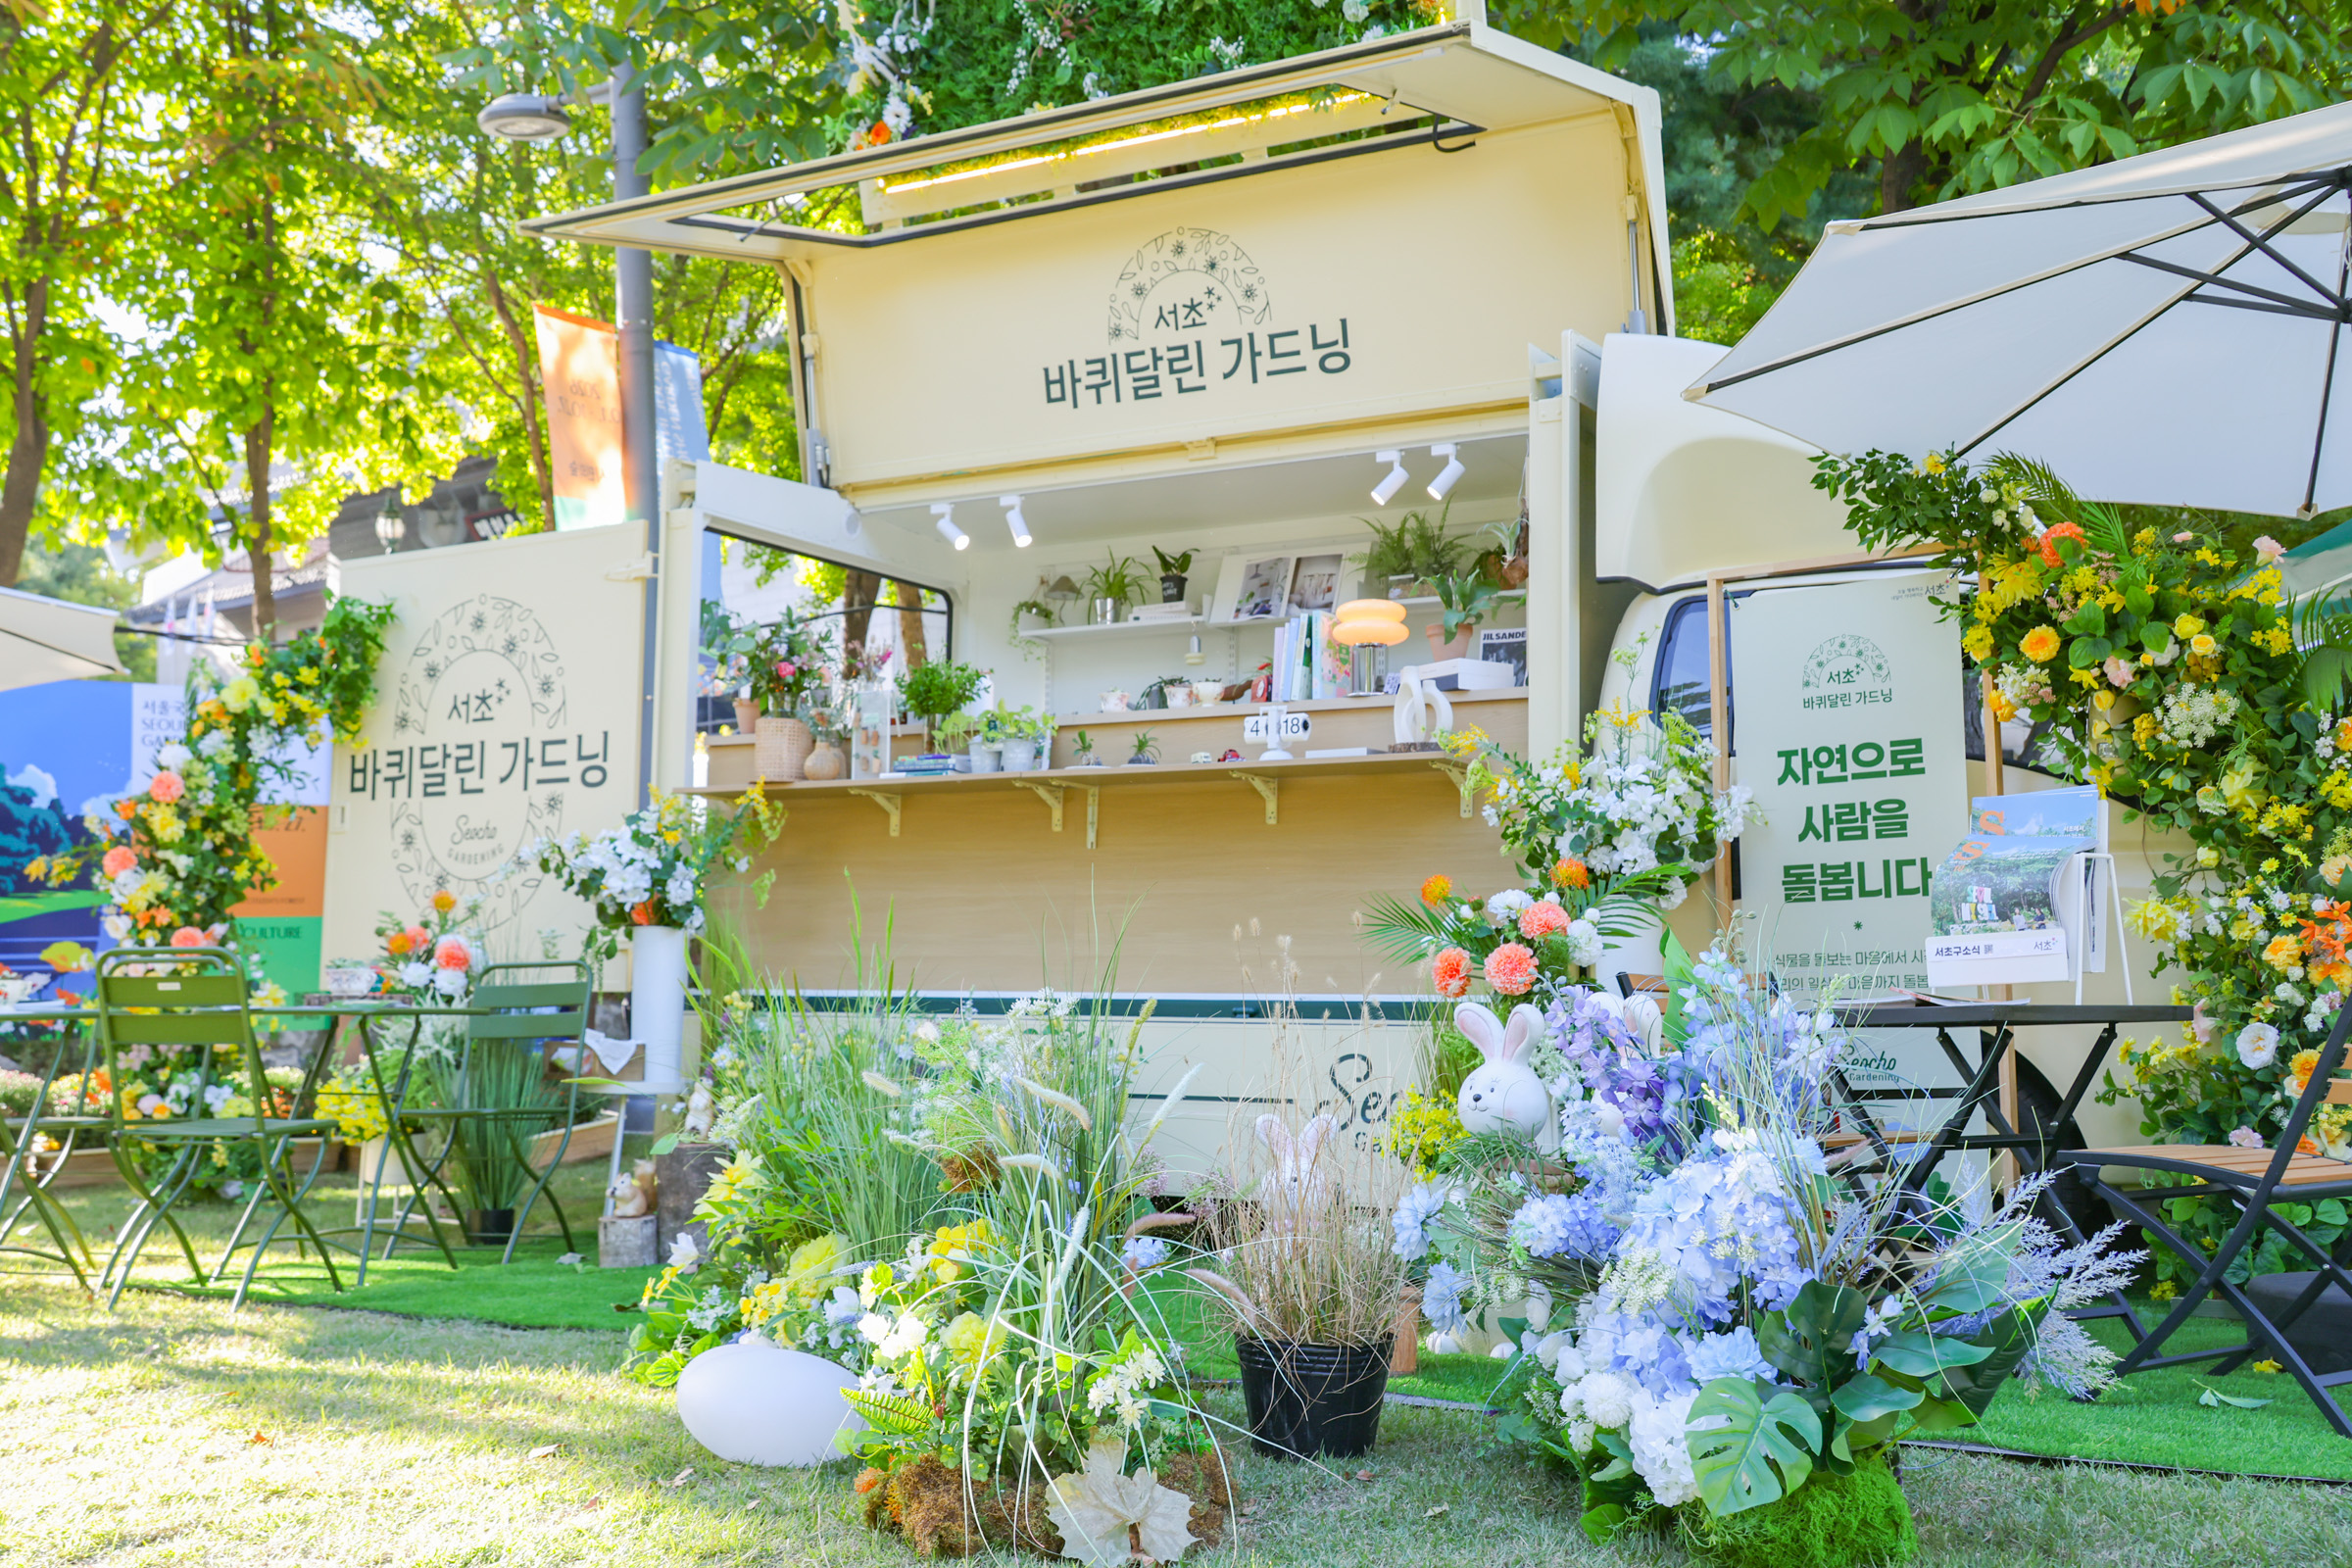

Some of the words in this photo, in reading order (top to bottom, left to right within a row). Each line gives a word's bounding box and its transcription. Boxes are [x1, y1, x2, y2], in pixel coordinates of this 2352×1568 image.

[1154, 297, 1207, 331] 서초
[1043, 340, 1206, 409] 바퀴달린
[1221, 318, 1351, 384] 가드닝
[1925, 583, 1946, 595] 서초
[1495, 631, 1527, 640] SANDE
[1827, 667, 1856, 685] 서초
[448, 687, 495, 724] 서초
[1803, 692, 1851, 710] 바퀴달린
[1855, 688, 1893, 706] 가드닝
[1250, 720, 1260, 736] 4
[1283, 717, 1300, 734] 18
[350, 740, 485, 801] 바퀴달린
[500, 731, 610, 792] 가드닝
[1777, 738, 1926, 786] 자연으로
[1797, 799, 1909, 843] 사람을
[1782, 857, 1933, 904] 돌봅니다
[1935, 945, 1981, 957] 서초구소식
[2034, 940, 2053, 952] 서초
[1775, 953, 1810, 968] 식물을
[1814, 952, 1851, 967] 돌보는
[1856, 950, 1907, 965] 마음에서
[1911, 950, 1928, 963] 시
[1903, 974, 1929, 989] 돌봅
